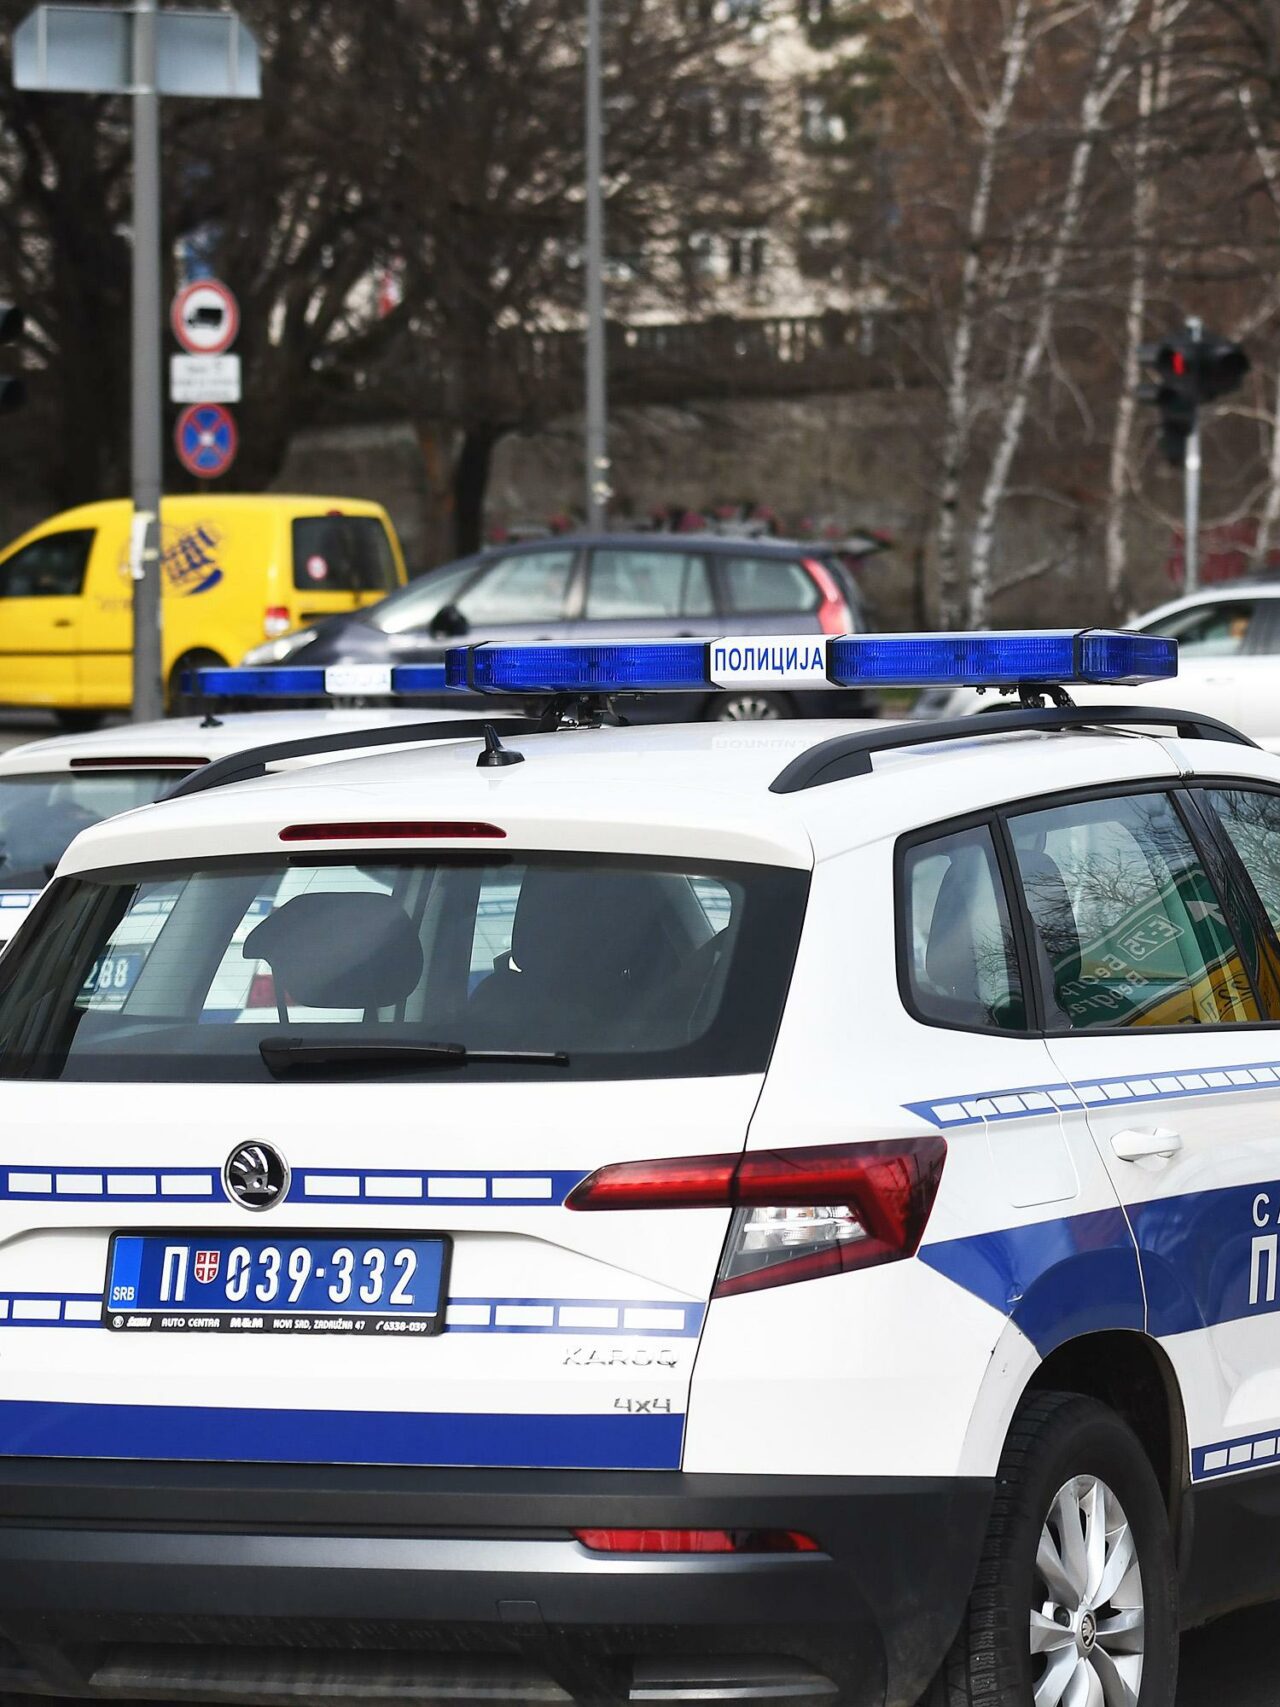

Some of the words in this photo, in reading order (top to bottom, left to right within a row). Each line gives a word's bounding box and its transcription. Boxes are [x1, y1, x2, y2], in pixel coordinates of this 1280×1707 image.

[715, 647, 824, 675] ПОЛИЦИЈА
[159, 1246, 189, 1302] П
[113, 1286, 135, 1301] SRB
[161, 1316, 186, 1328] AUTO
[273, 1319, 293, 1329] NOVI
[355, 1320, 366, 1330] 47
[562, 1347, 678, 1368] KAROQ
[614, 1398, 671, 1413] 4x4
